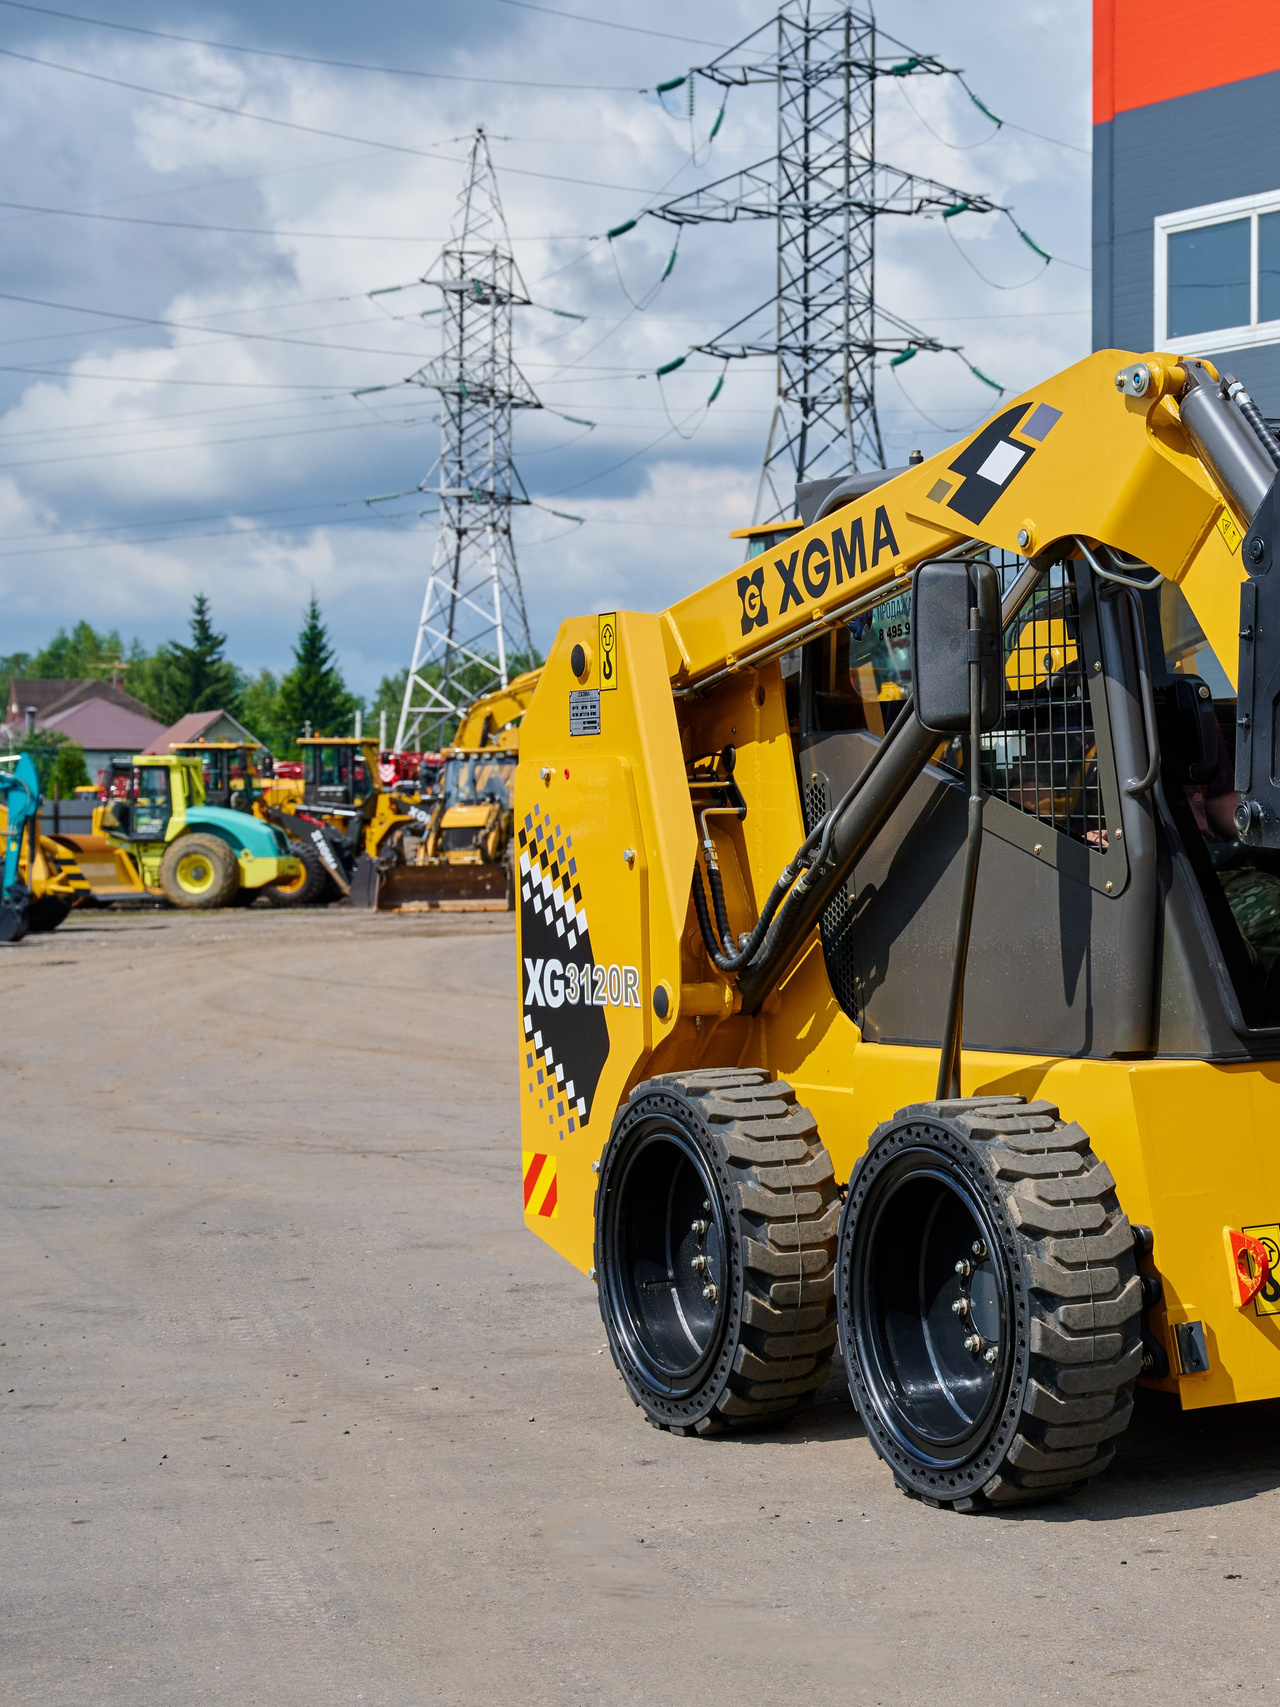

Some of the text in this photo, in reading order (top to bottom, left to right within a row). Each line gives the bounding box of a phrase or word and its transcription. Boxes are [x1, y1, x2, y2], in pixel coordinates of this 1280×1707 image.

[773, 504, 901, 616] XGMA
[879, 628, 885, 641] 8
[886, 623, 903, 639] 495
[523, 957, 642, 1009] XG3120R
